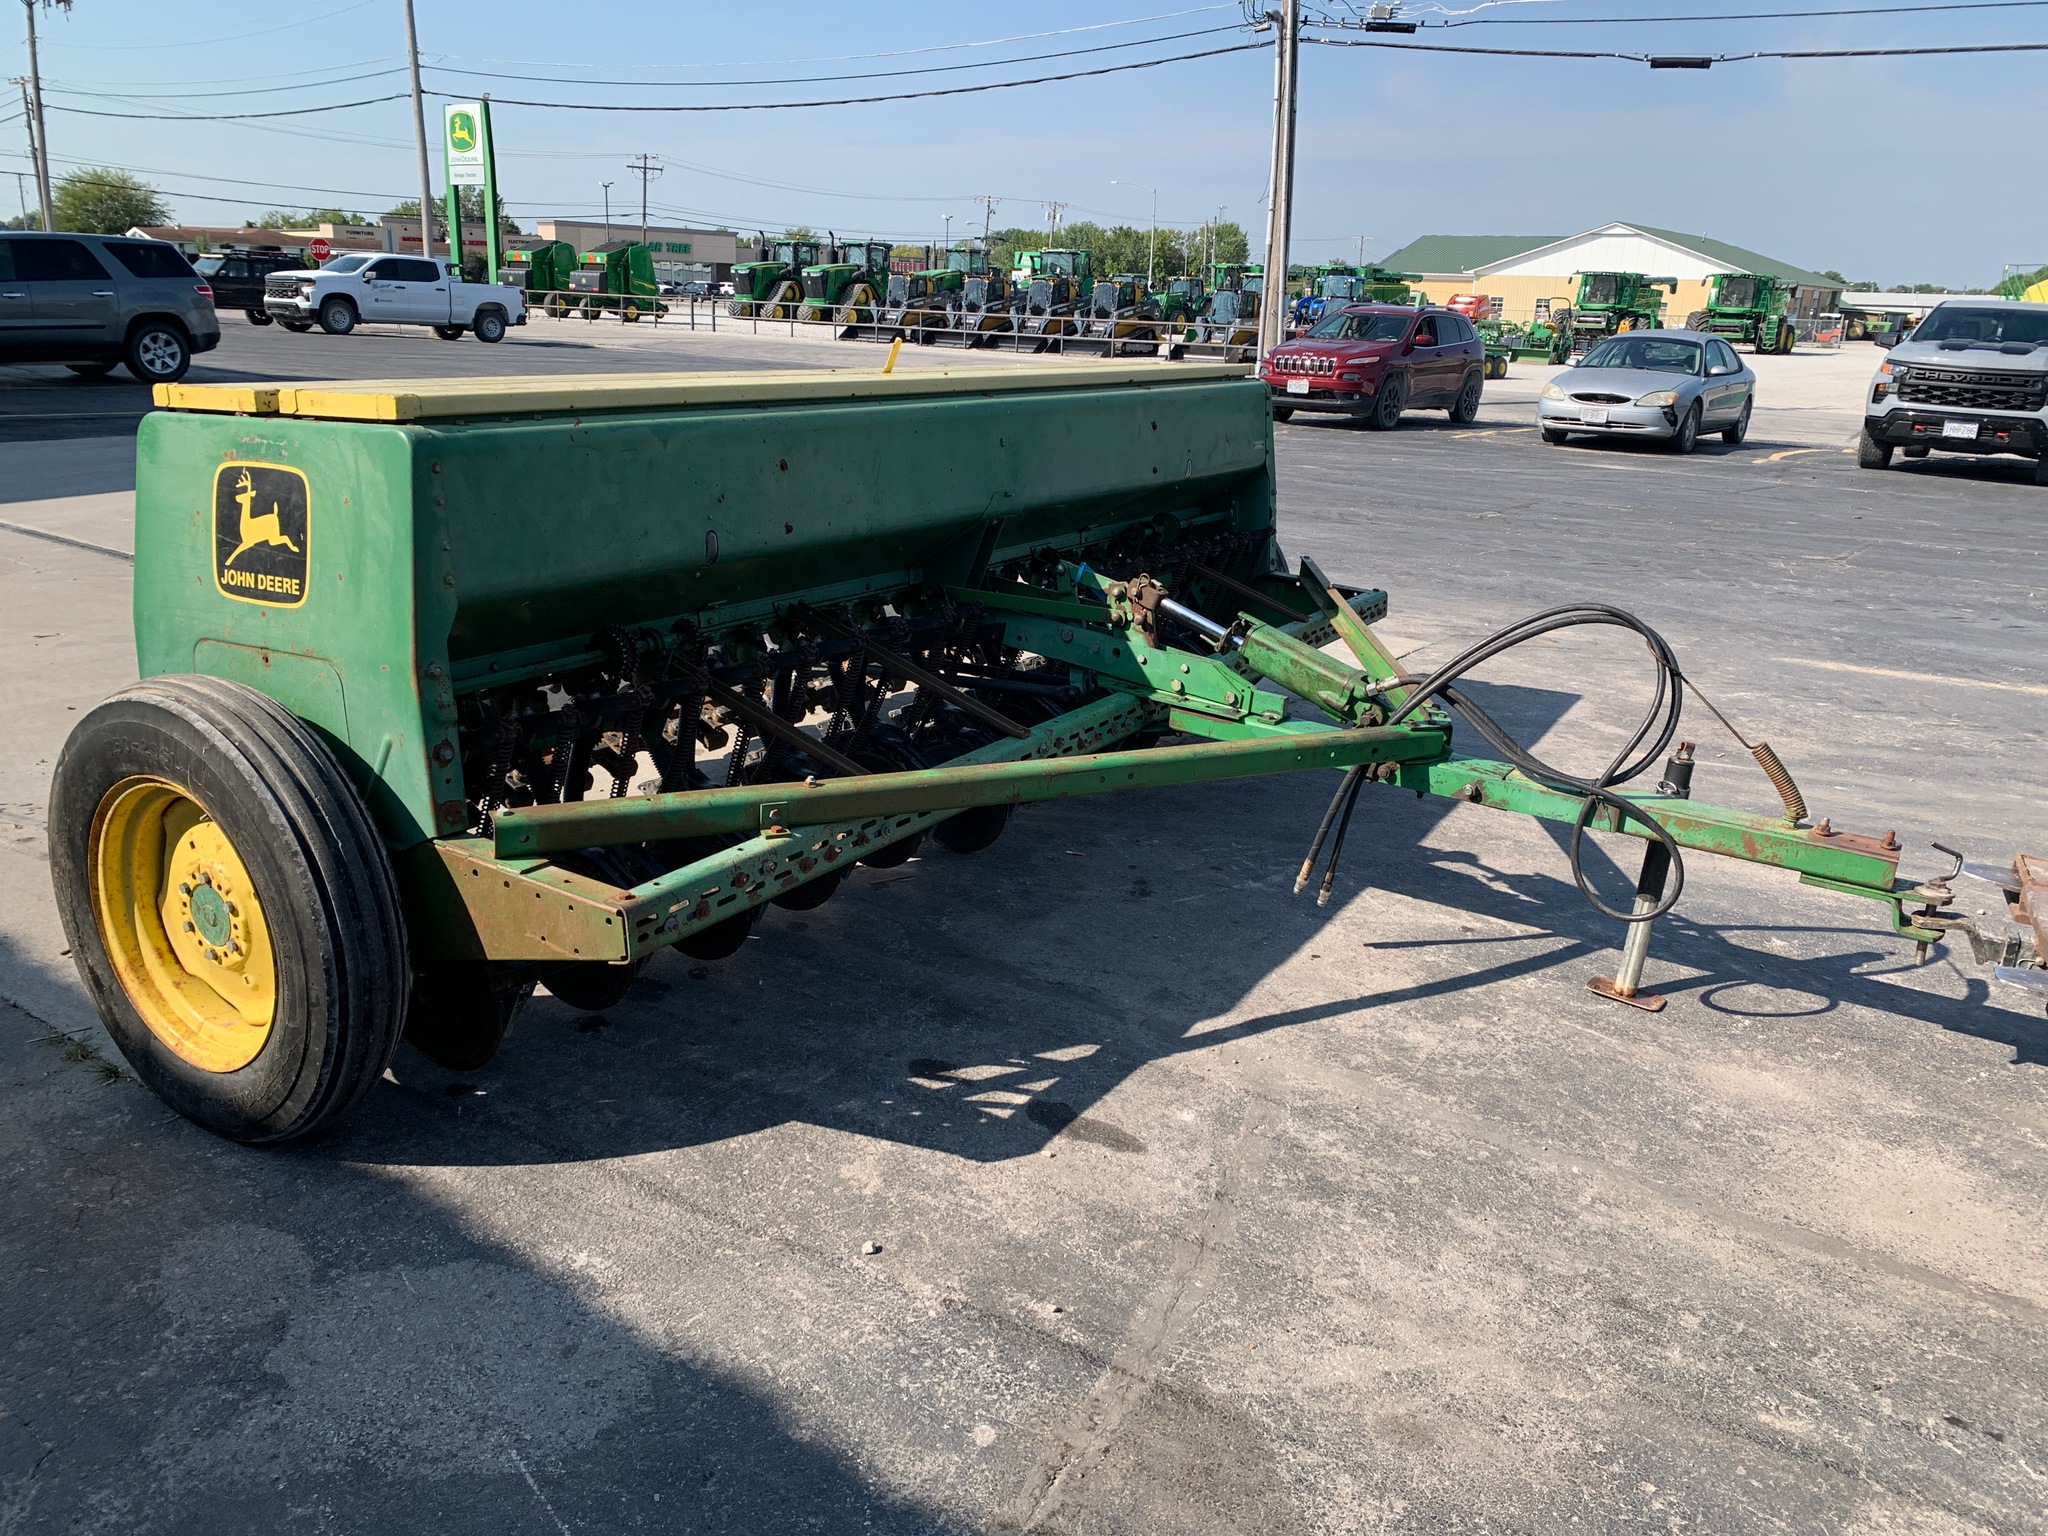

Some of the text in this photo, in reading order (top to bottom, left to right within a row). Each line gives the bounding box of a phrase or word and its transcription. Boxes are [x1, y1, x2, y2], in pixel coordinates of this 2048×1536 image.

[461, 155, 479, 163] DEERE
[311, 245, 330, 254] STOP
[666, 242, 692, 254] TREE
[1911, 370, 2039, 387] CHEVROLET
[221, 569, 300, 595] JOHN DEERE
